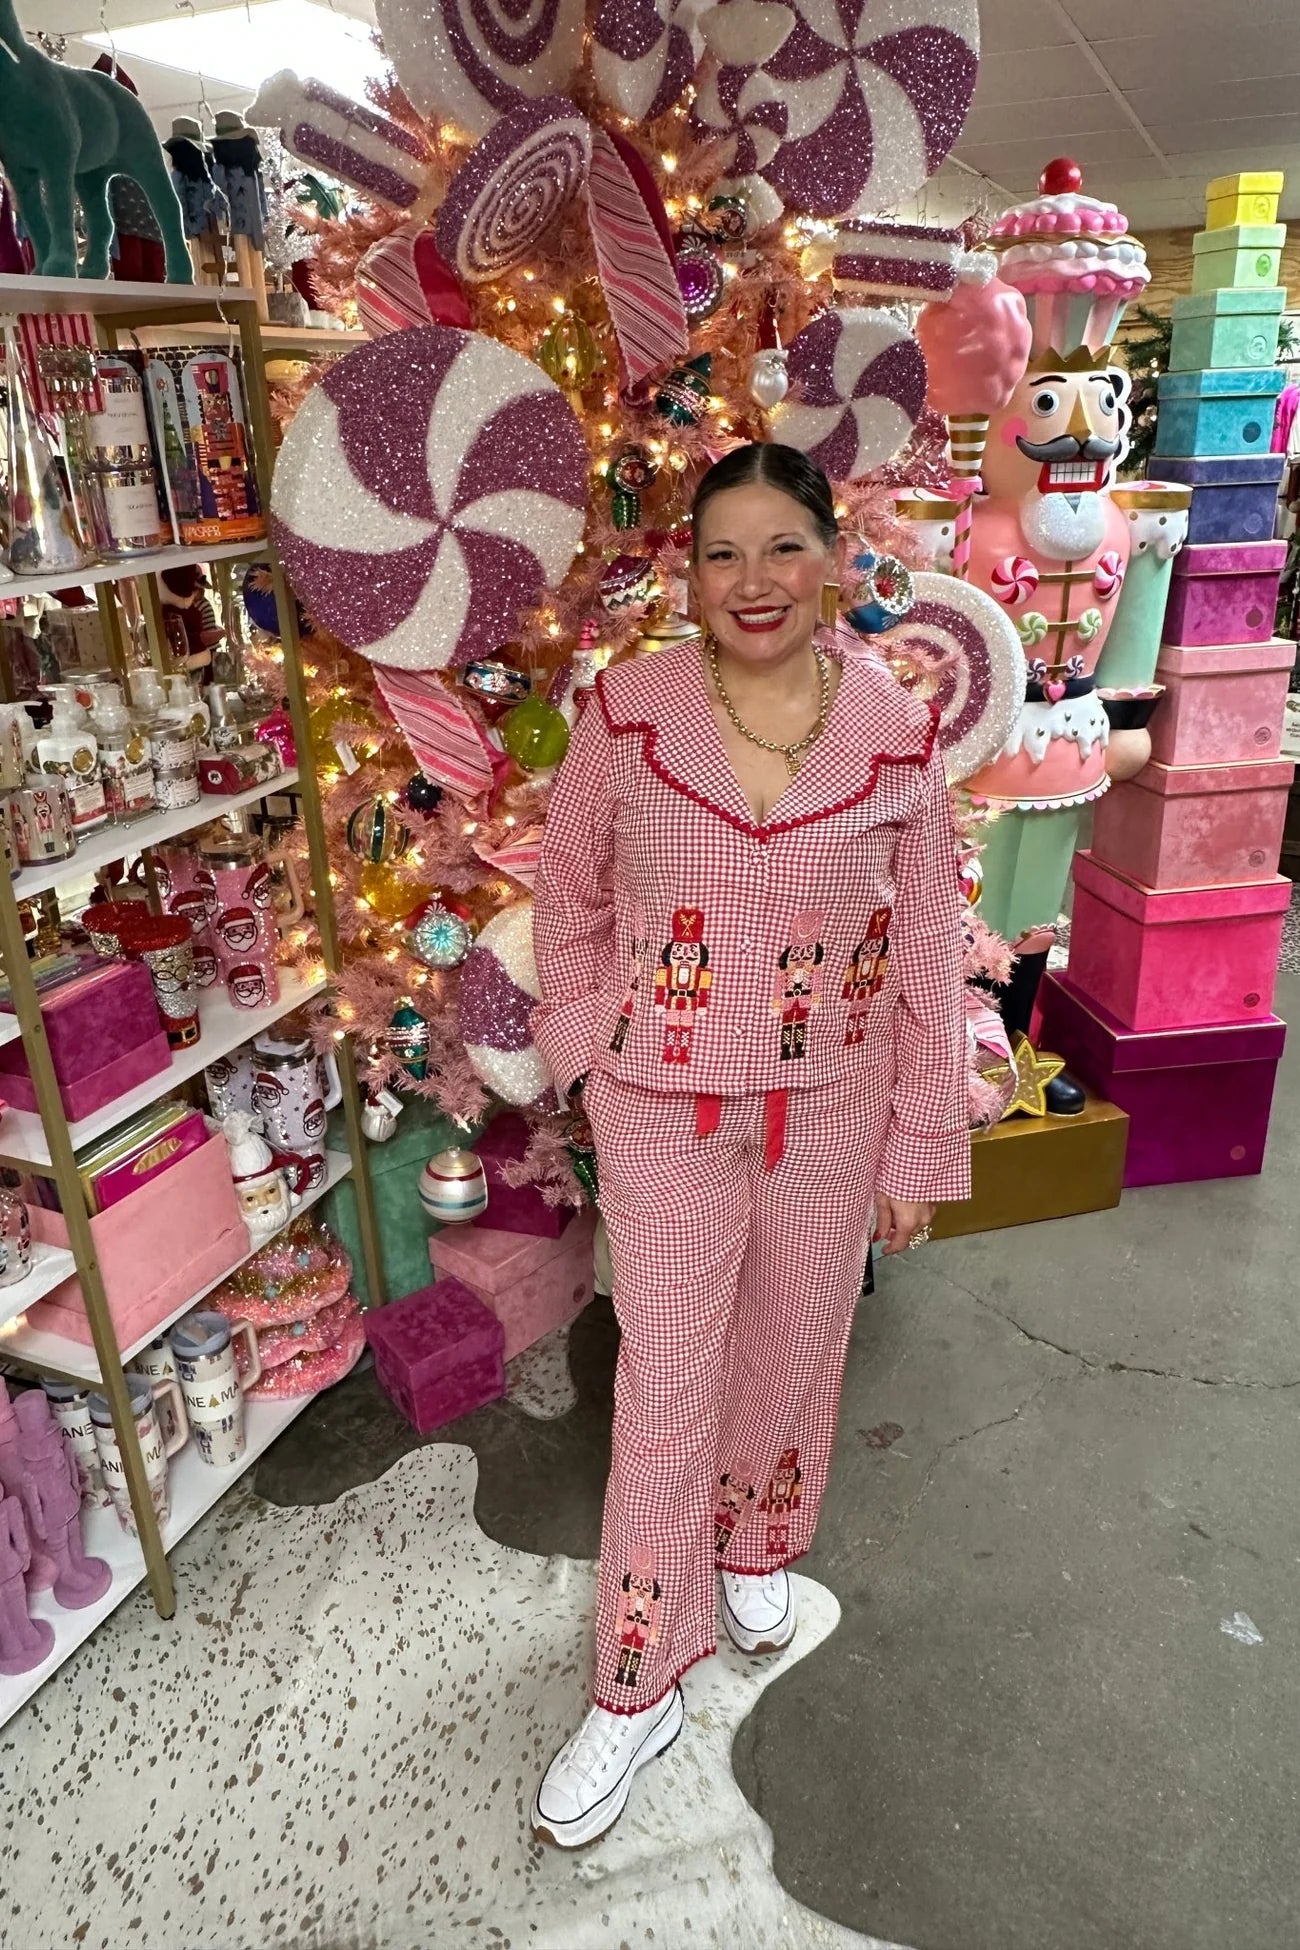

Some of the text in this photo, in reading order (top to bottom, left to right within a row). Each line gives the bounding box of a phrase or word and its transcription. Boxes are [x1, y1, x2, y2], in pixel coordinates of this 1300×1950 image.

[186, 1380, 239, 1408] NE MA
[61, 1422, 96, 1439] ANE
[101, 1439, 162, 1473] AN MA
